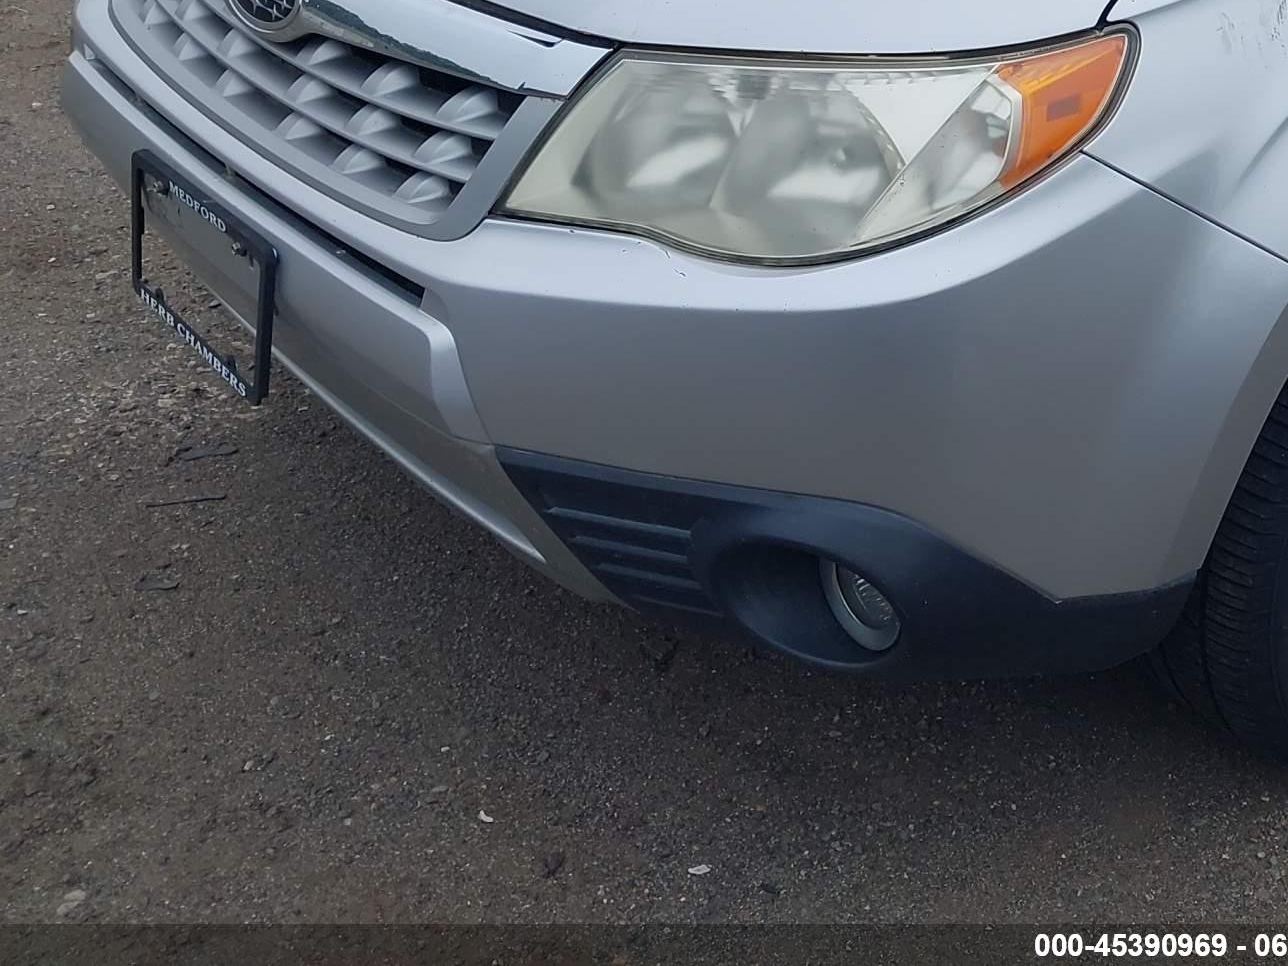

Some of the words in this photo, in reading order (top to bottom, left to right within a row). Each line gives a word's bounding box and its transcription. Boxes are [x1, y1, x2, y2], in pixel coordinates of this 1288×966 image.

[169, 180, 227, 234] MEDFORD
[140, 288, 175, 328] HERB
[176, 322, 247, 398] CHAMBERS
